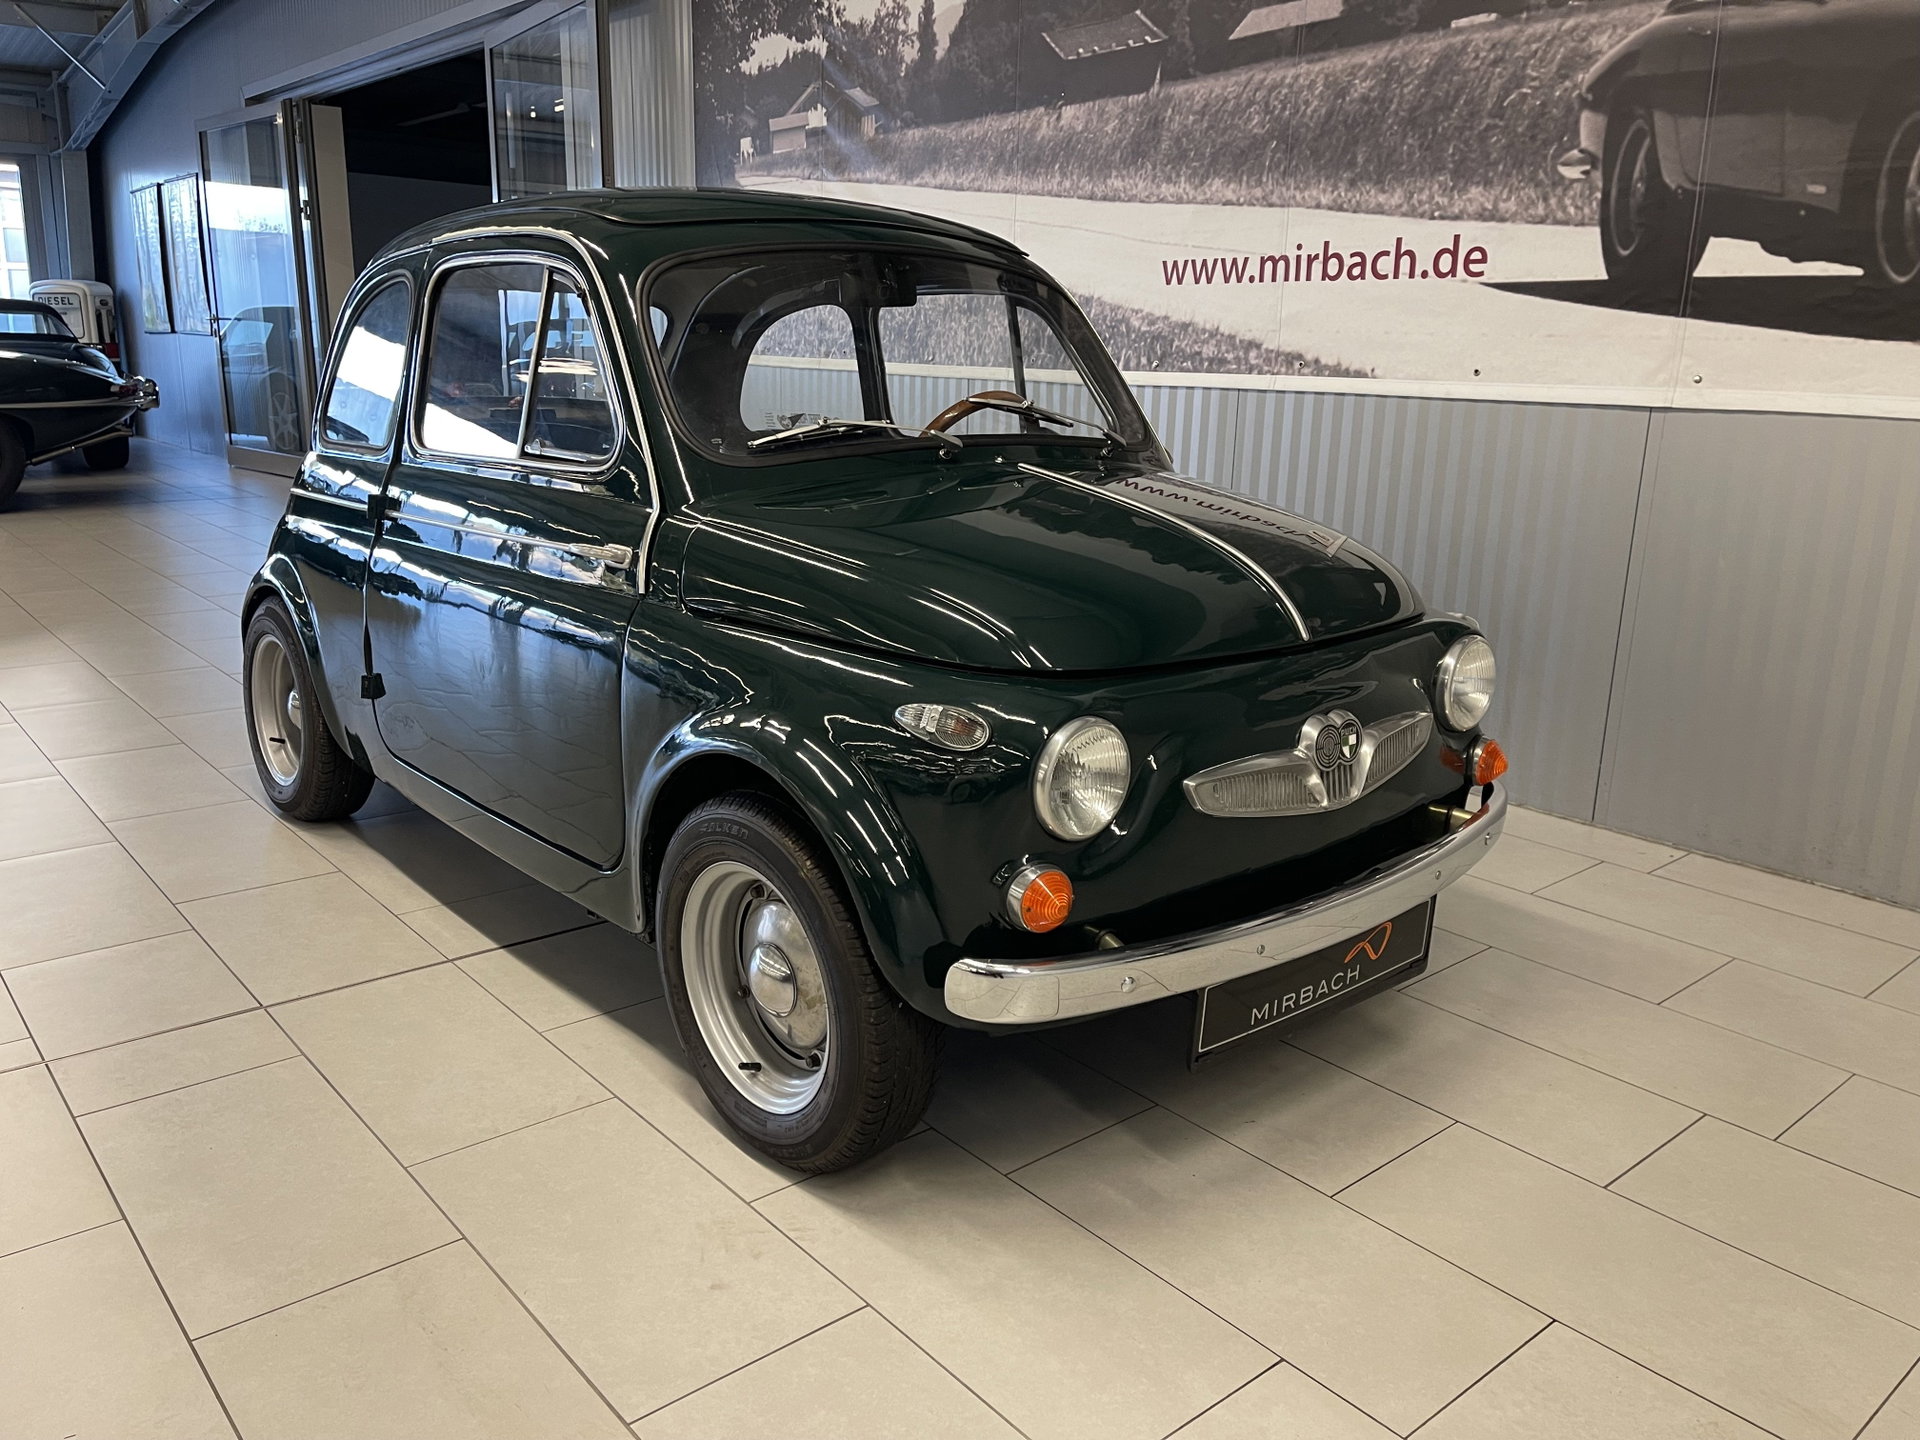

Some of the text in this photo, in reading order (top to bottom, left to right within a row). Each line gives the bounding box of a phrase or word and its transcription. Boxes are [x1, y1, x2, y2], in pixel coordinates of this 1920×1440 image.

[1162, 234, 1489, 285] www.mirbach.de
[38, 296, 74, 305] DIESEL
[1250, 964, 1361, 1026] MIRBACH
